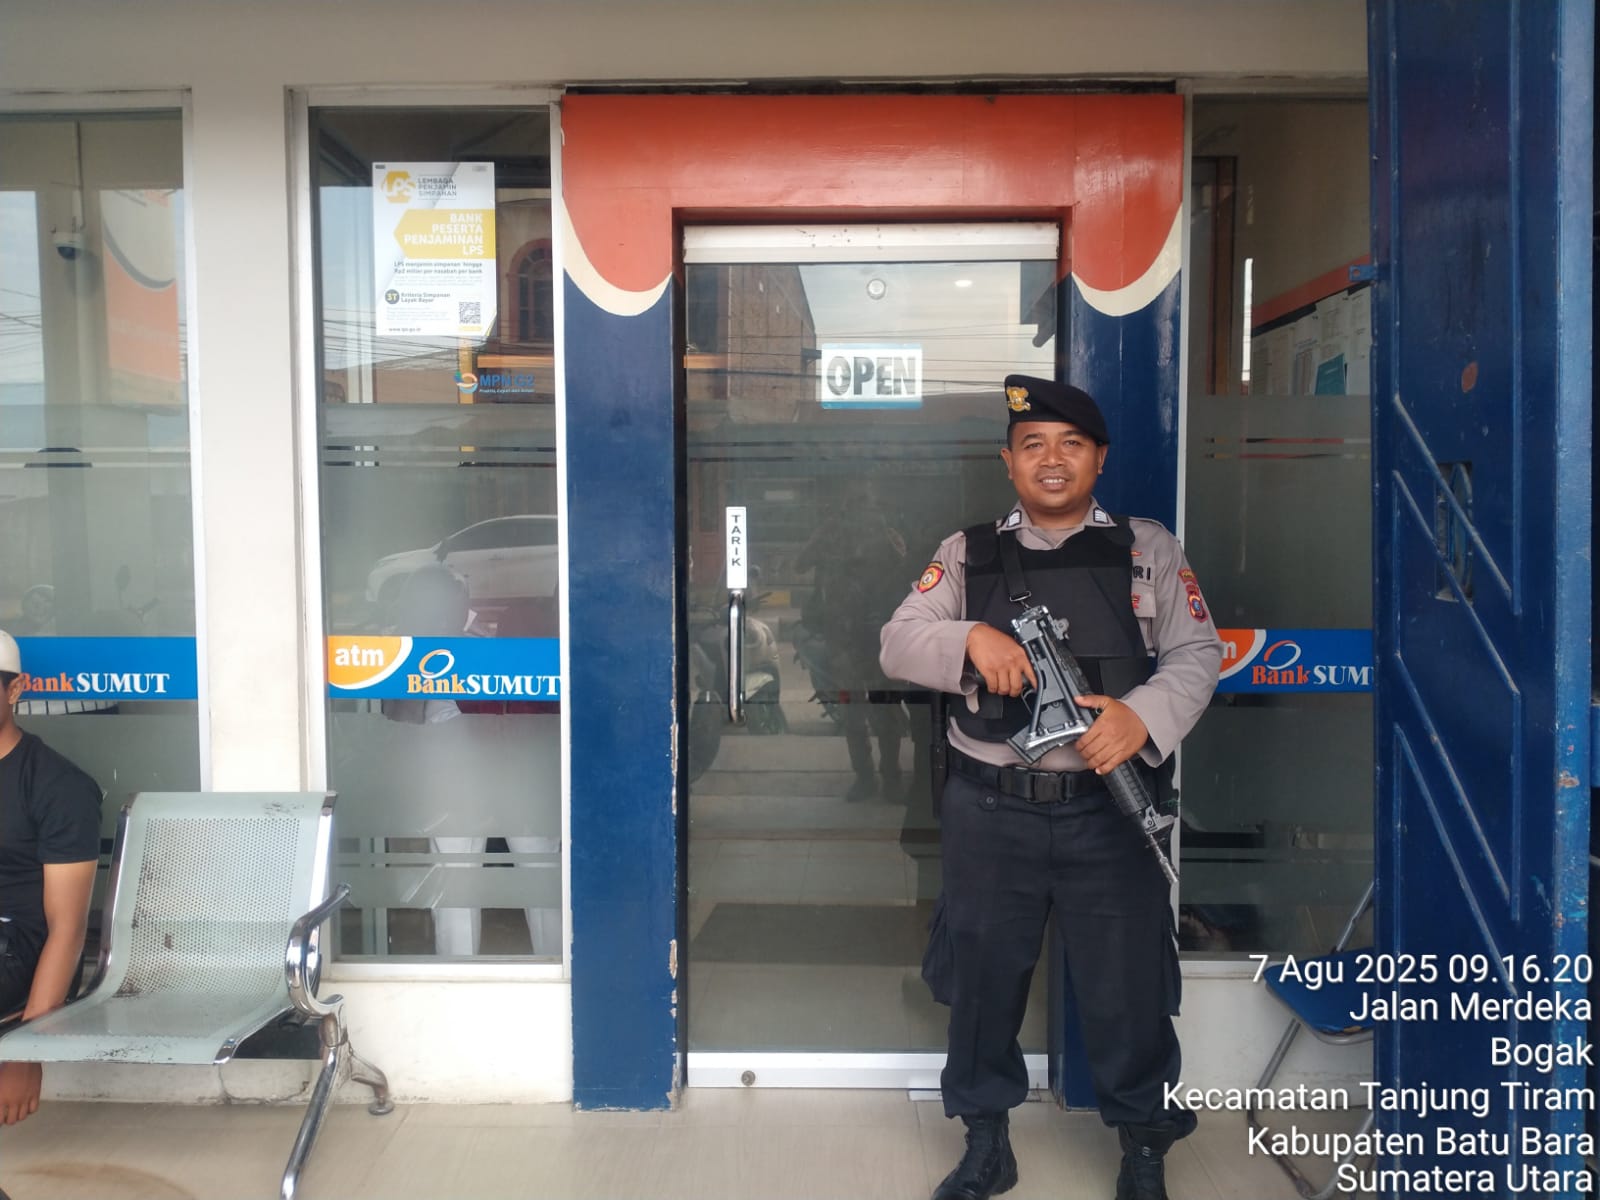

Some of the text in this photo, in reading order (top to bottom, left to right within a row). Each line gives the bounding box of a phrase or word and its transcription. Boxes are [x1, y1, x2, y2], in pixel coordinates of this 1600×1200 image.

[450, 213, 483, 223] BANK
[432, 223, 483, 234] PESERTA
[403, 234, 484, 244] PENJAMINAN
[462, 245, 484, 256] LPS
[480, 374, 513, 387] MPN
[826, 355, 917, 396] OPEN
[731, 514, 742, 567] TARIK
[1132, 565, 1152, 581] RI
[334, 644, 385, 667] atm
